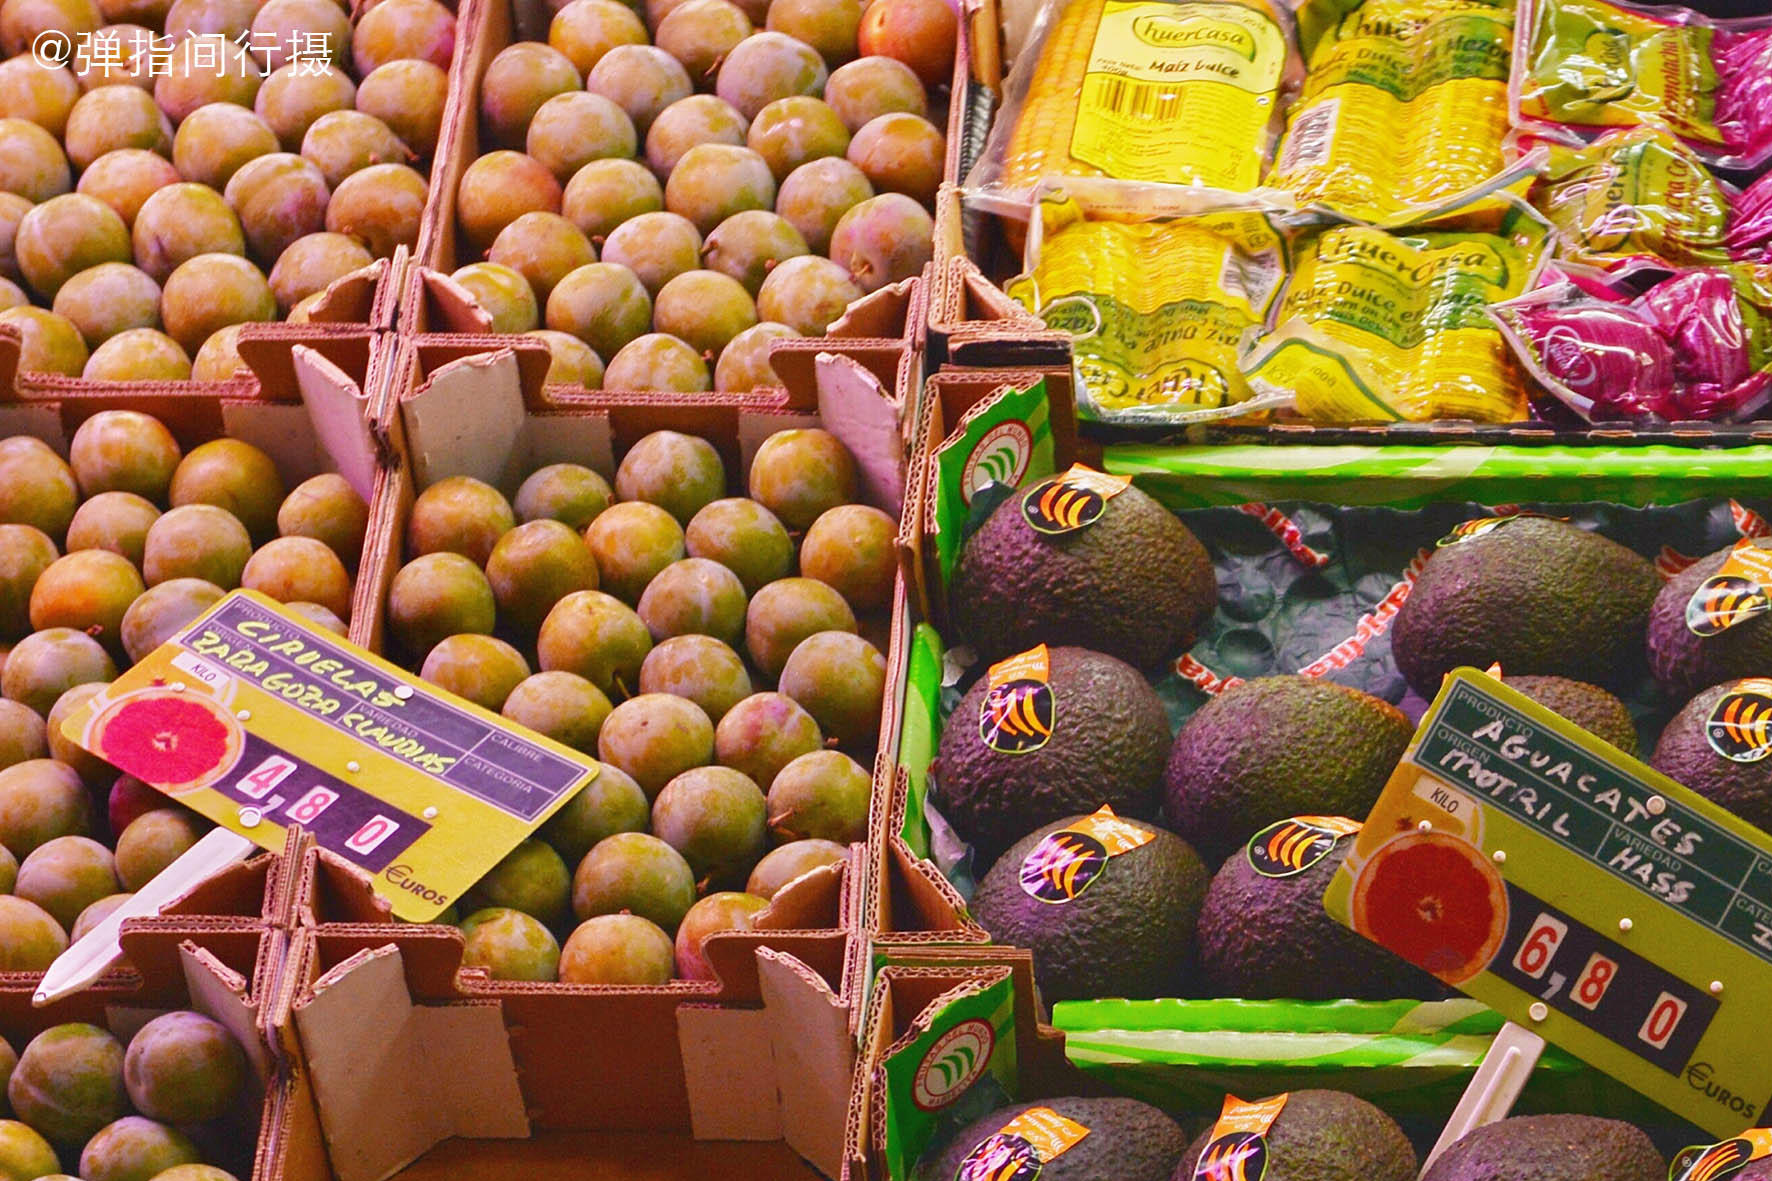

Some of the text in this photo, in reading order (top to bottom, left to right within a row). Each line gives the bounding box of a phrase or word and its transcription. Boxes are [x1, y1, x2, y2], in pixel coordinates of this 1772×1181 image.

[189, 661, 218, 683] KILO
[236, 617, 408, 710] CIRUELAS
[490, 731, 543, 763] CALIBRE
[1437, 728, 1491, 765] ORIGEN
[1429, 784, 1460, 814] KILO
[1471, 719, 1705, 857] AGUACATES
[1612, 826, 1683, 872] VARIEDAD
[1607, 846, 1697, 904] HASS
